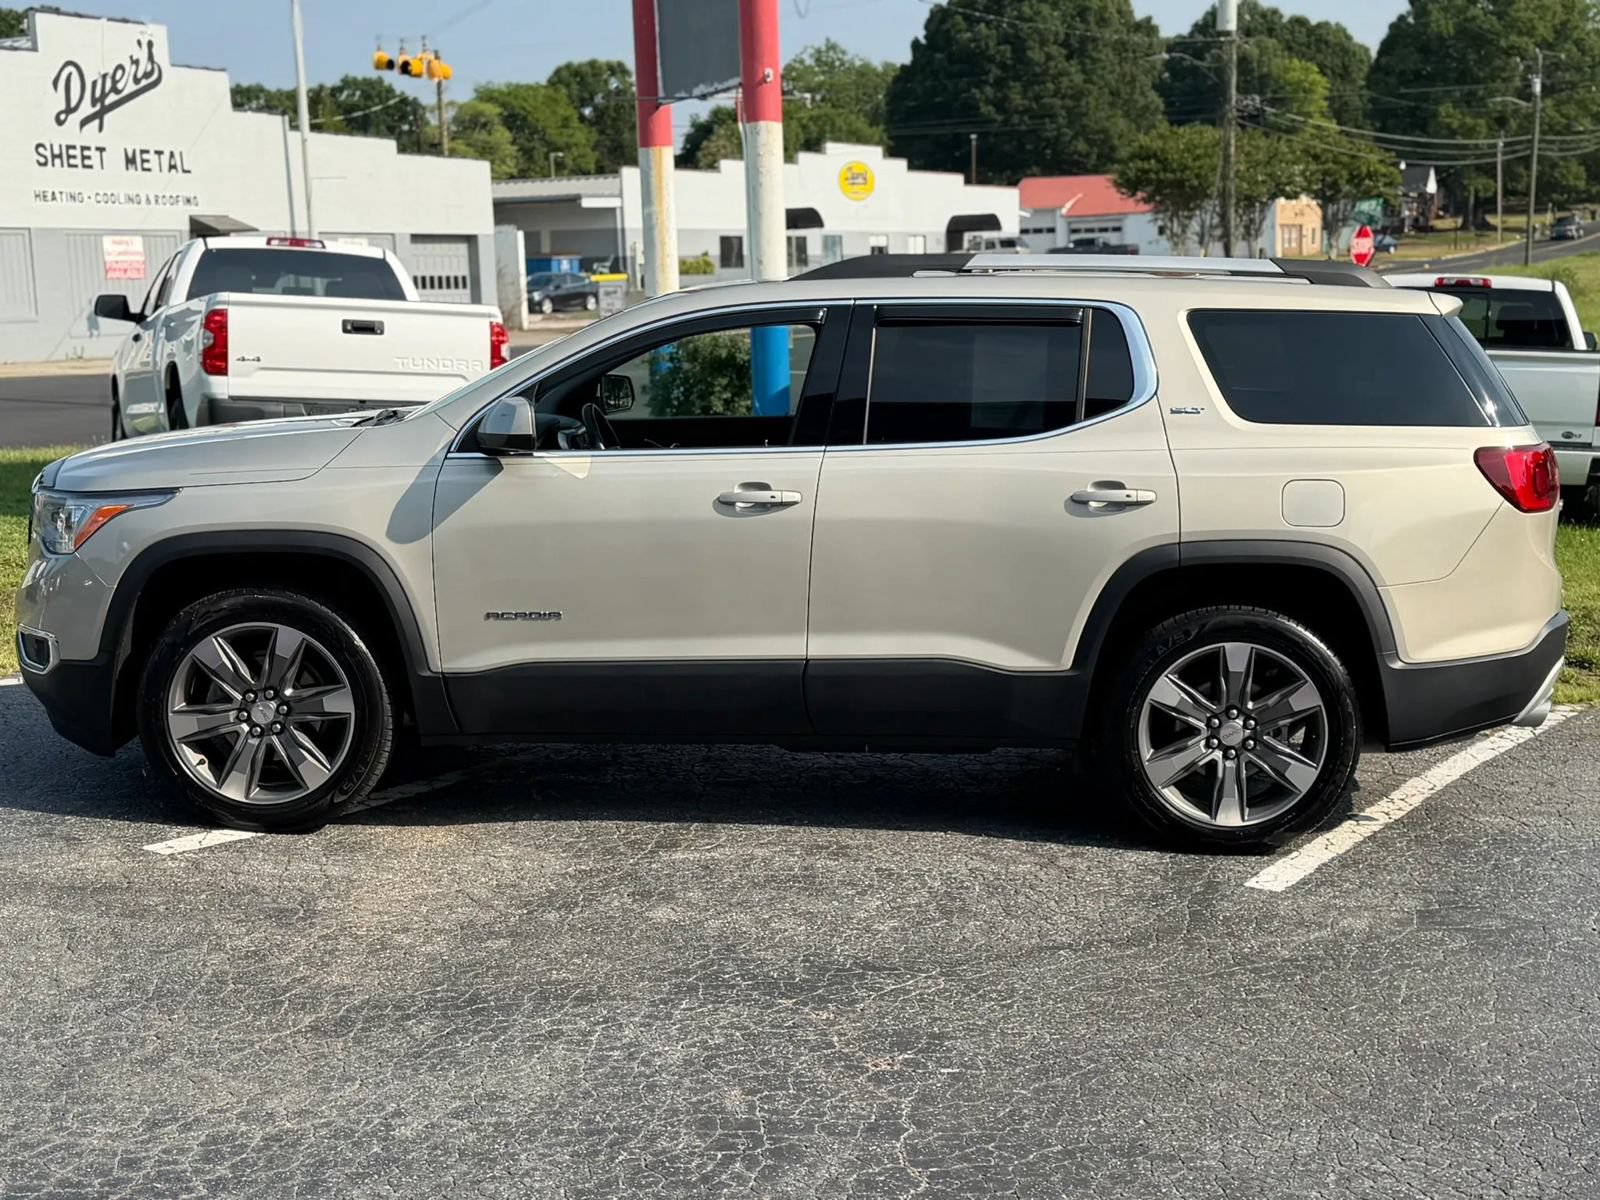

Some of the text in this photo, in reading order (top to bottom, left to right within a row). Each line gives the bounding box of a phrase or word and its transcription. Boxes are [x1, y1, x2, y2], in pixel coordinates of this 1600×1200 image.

[52, 38, 163, 133] Dyer's
[34, 142, 192, 174] SHEET METAL
[33, 189, 85, 204] HEATING
[94, 191, 142, 206] COOLING
[154, 194, 200, 208] ROOFING
[394, 355, 485, 372] TUNDRA
[483, 611, 563, 621] ACADIA
